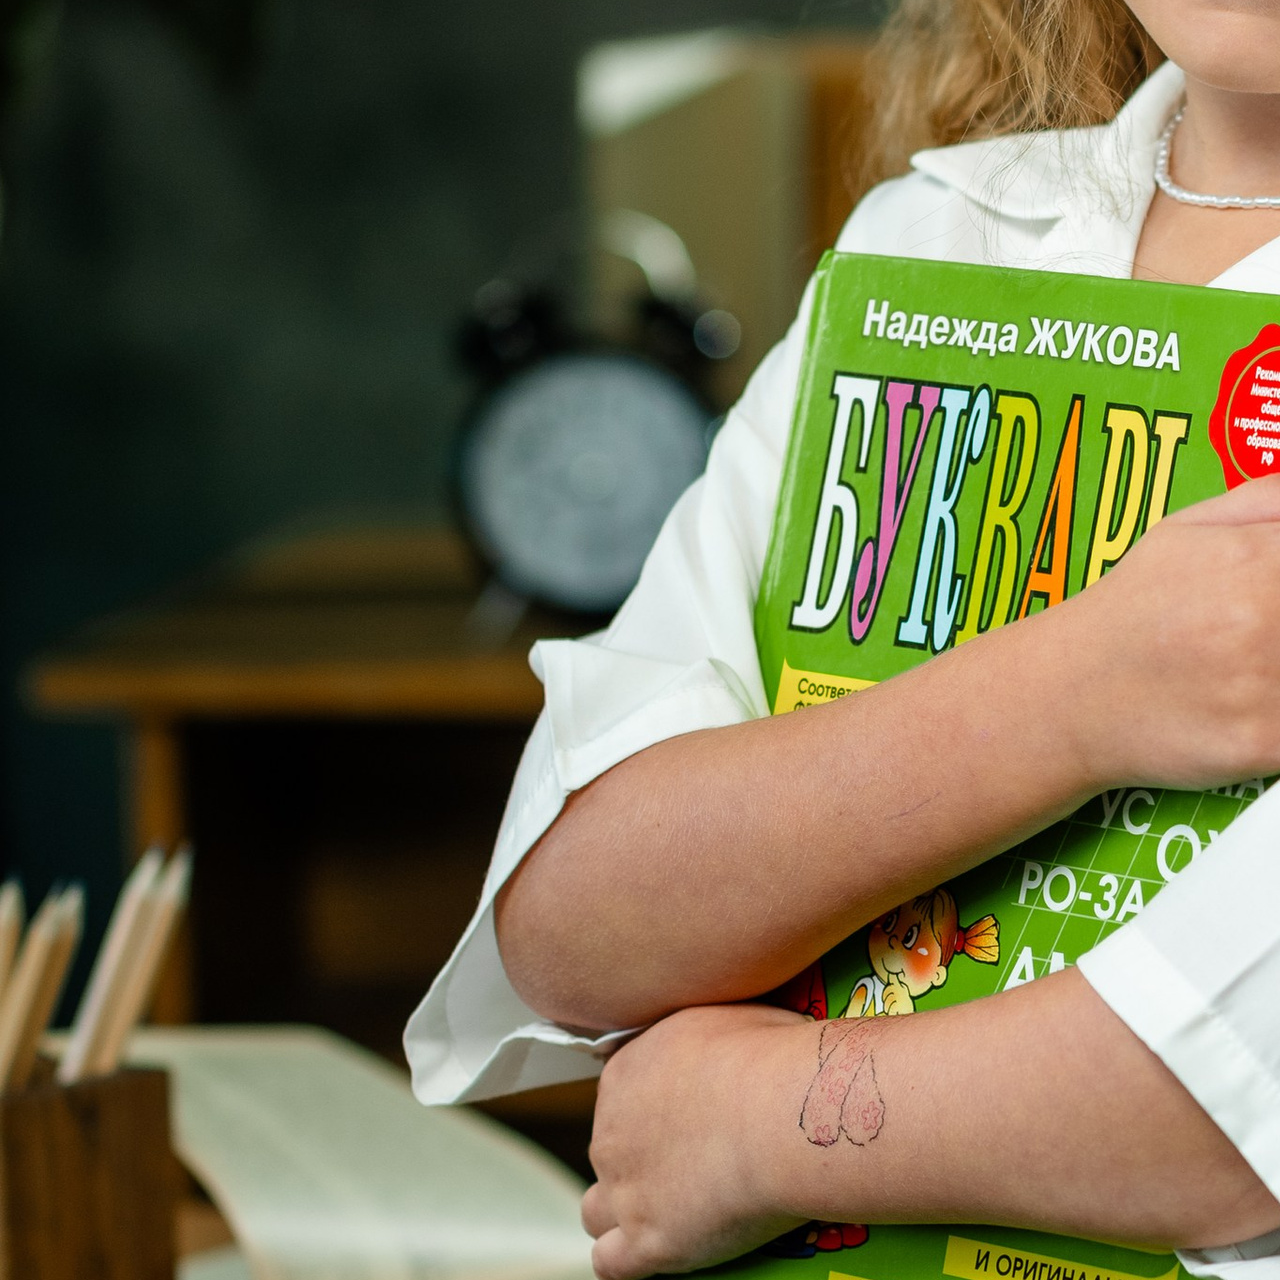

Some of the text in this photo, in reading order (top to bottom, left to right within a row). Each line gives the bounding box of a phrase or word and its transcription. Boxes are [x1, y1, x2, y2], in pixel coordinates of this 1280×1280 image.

[862, 298, 1181, 371] Надежда ЖУКОВА
[1233, 416, 1240, 427] и
[1261, 451, 1274, 466] РФ
[1156, 824, 1219, 883] О
[1018, 861, 1144, 922] РО-ЗА
[973, 1248, 991, 1271] И
